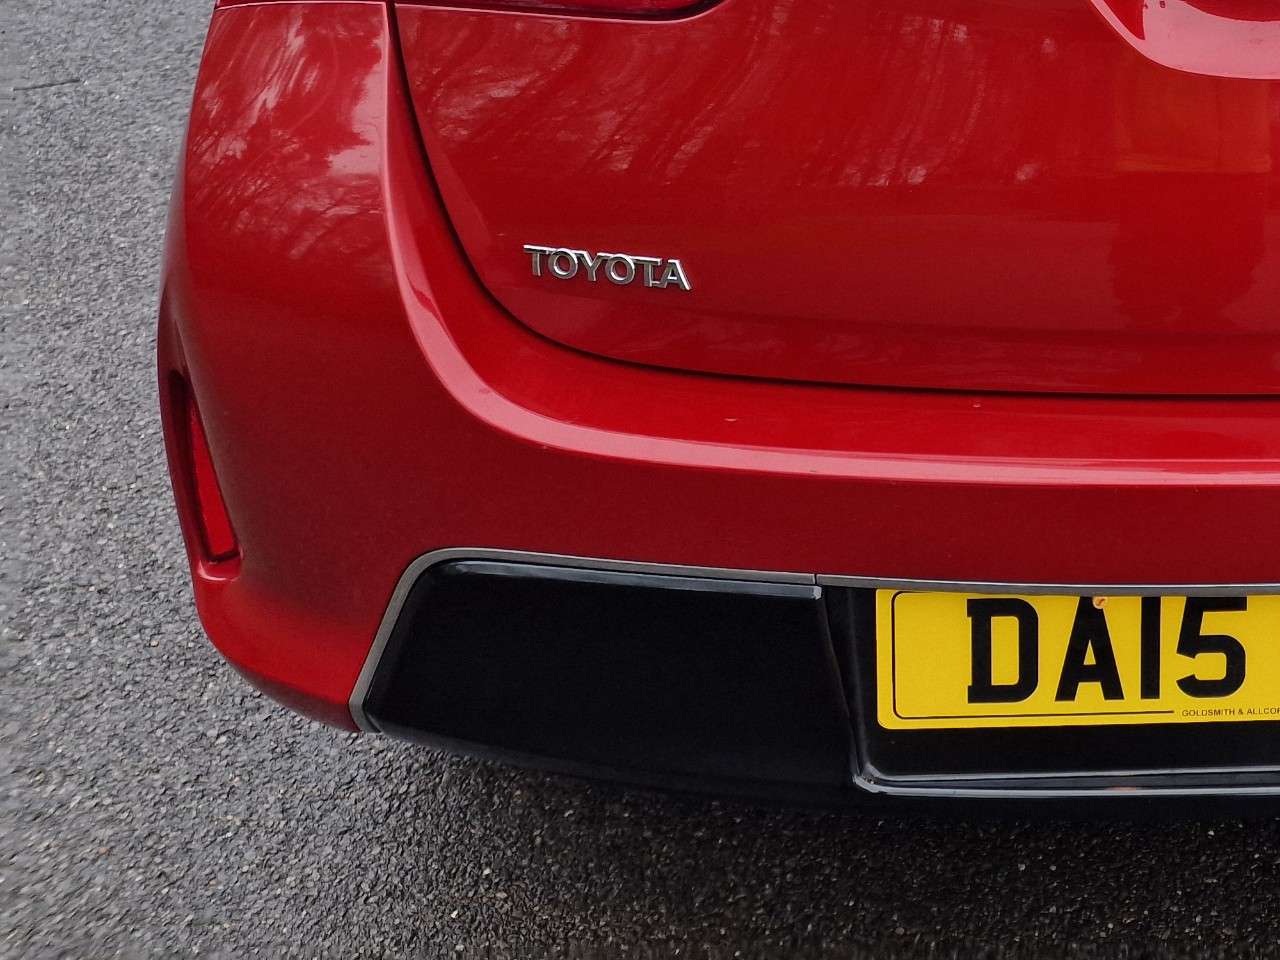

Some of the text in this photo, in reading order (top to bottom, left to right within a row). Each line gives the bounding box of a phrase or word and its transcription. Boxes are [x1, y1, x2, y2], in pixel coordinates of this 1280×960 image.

[523, 244, 692, 291] TOYOTA
[967, 595, 1248, 705] DA15
[1181, 708, 1236, 717] GOLDSMITH
